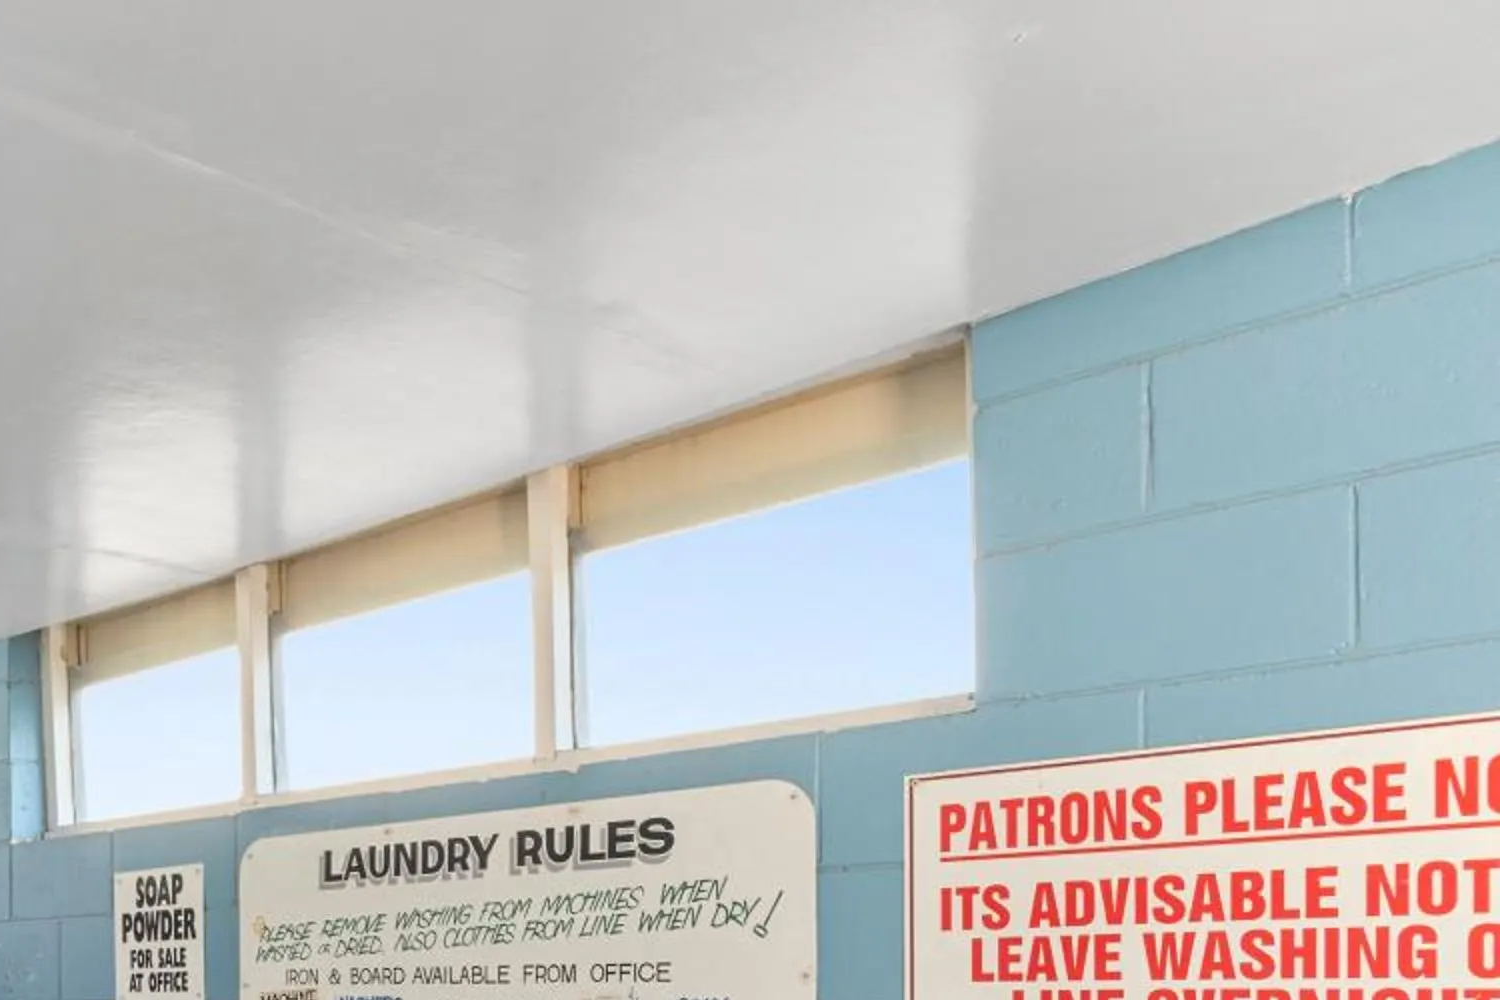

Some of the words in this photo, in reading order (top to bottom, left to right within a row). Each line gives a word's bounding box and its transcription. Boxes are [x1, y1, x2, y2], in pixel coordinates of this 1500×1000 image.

[940, 785, 1163, 852] PATRONS
[1185, 763, 1407, 836] PLEASE
[322, 832, 499, 884] LAUNDRY
[514, 817, 675, 868] RULES
[135, 873, 183, 908] SOAP
[260, 921, 317, 943] PLEASE
[322, 913, 387, 937] REMOVE
[395, 903, 474, 930] WASHING
[479, 898, 533, 922] FROM
[541, 885, 644, 917] MACHINES
[660, 875, 729, 906] WHEN
[940, 884, 1010, 931] ITS
[1029, 866, 1339, 928] ADVISABLE
[1366, 858, 1500, 917] NOT
[121, 907, 197, 944] POWDER
[394, 930, 437, 952] ALSO
[443, 922, 517, 948] CLOTHES
[522, 917, 575, 942] FROM
[579, 912, 628, 937] LINE
[638, 904, 702, 933] WHEN
[130, 948, 153, 969] FOR
[158, 946, 187, 969] SALE
[286, 968, 319, 985] IRON
[328, 967, 341, 984] &
[351, 966, 407, 985] BOARD
[412, 965, 511, 985] AVAILABLE
[523, 963, 577, 984] FROM
[590, 961, 672, 983] OFFICE
[971, 933, 1122, 982] LEAVE
[1143, 924, 1438, 981] WASHING
[129, 973, 143, 993] AT
[148, 971, 189, 993] OFFICE
